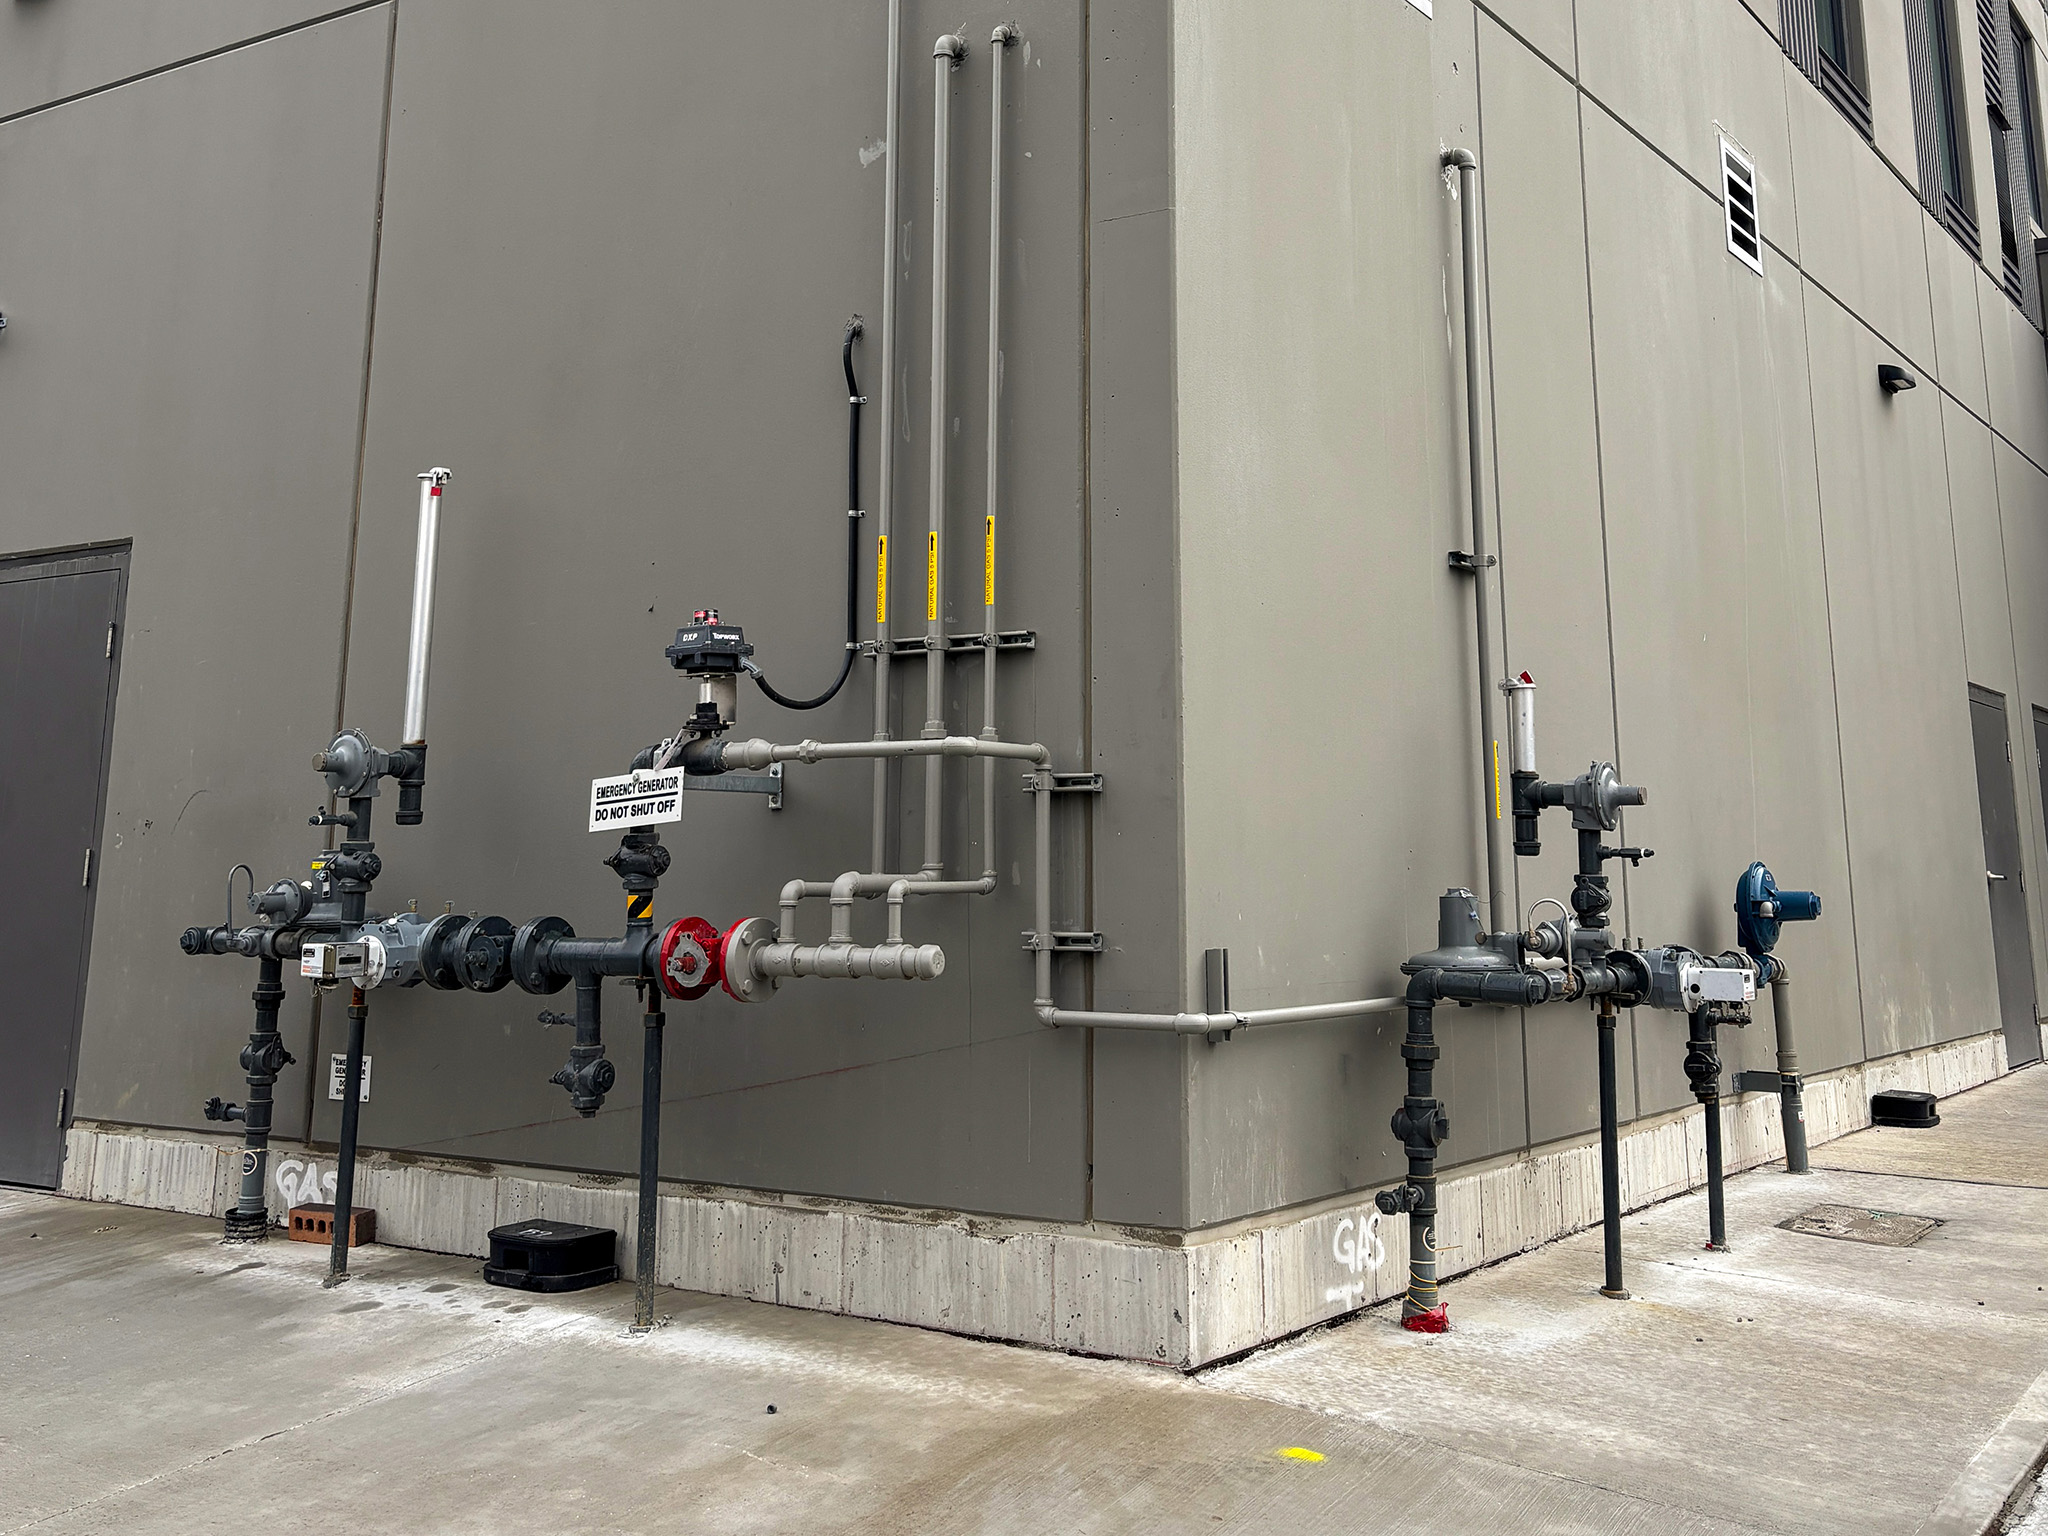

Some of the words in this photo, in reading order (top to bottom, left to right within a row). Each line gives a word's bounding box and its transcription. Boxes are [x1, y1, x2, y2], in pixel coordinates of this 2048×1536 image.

[682, 632, 698, 642] DXP
[596, 782, 637, 799] EMERGENCY
[638, 776, 678, 794] GENERATOR
[595, 808, 608, 821] DO
[610, 806, 629, 820] NOT
[630, 802, 655, 817] SHUT
[657, 799, 676, 813] OFF
[1333, 1212, 1385, 1274] GAS
